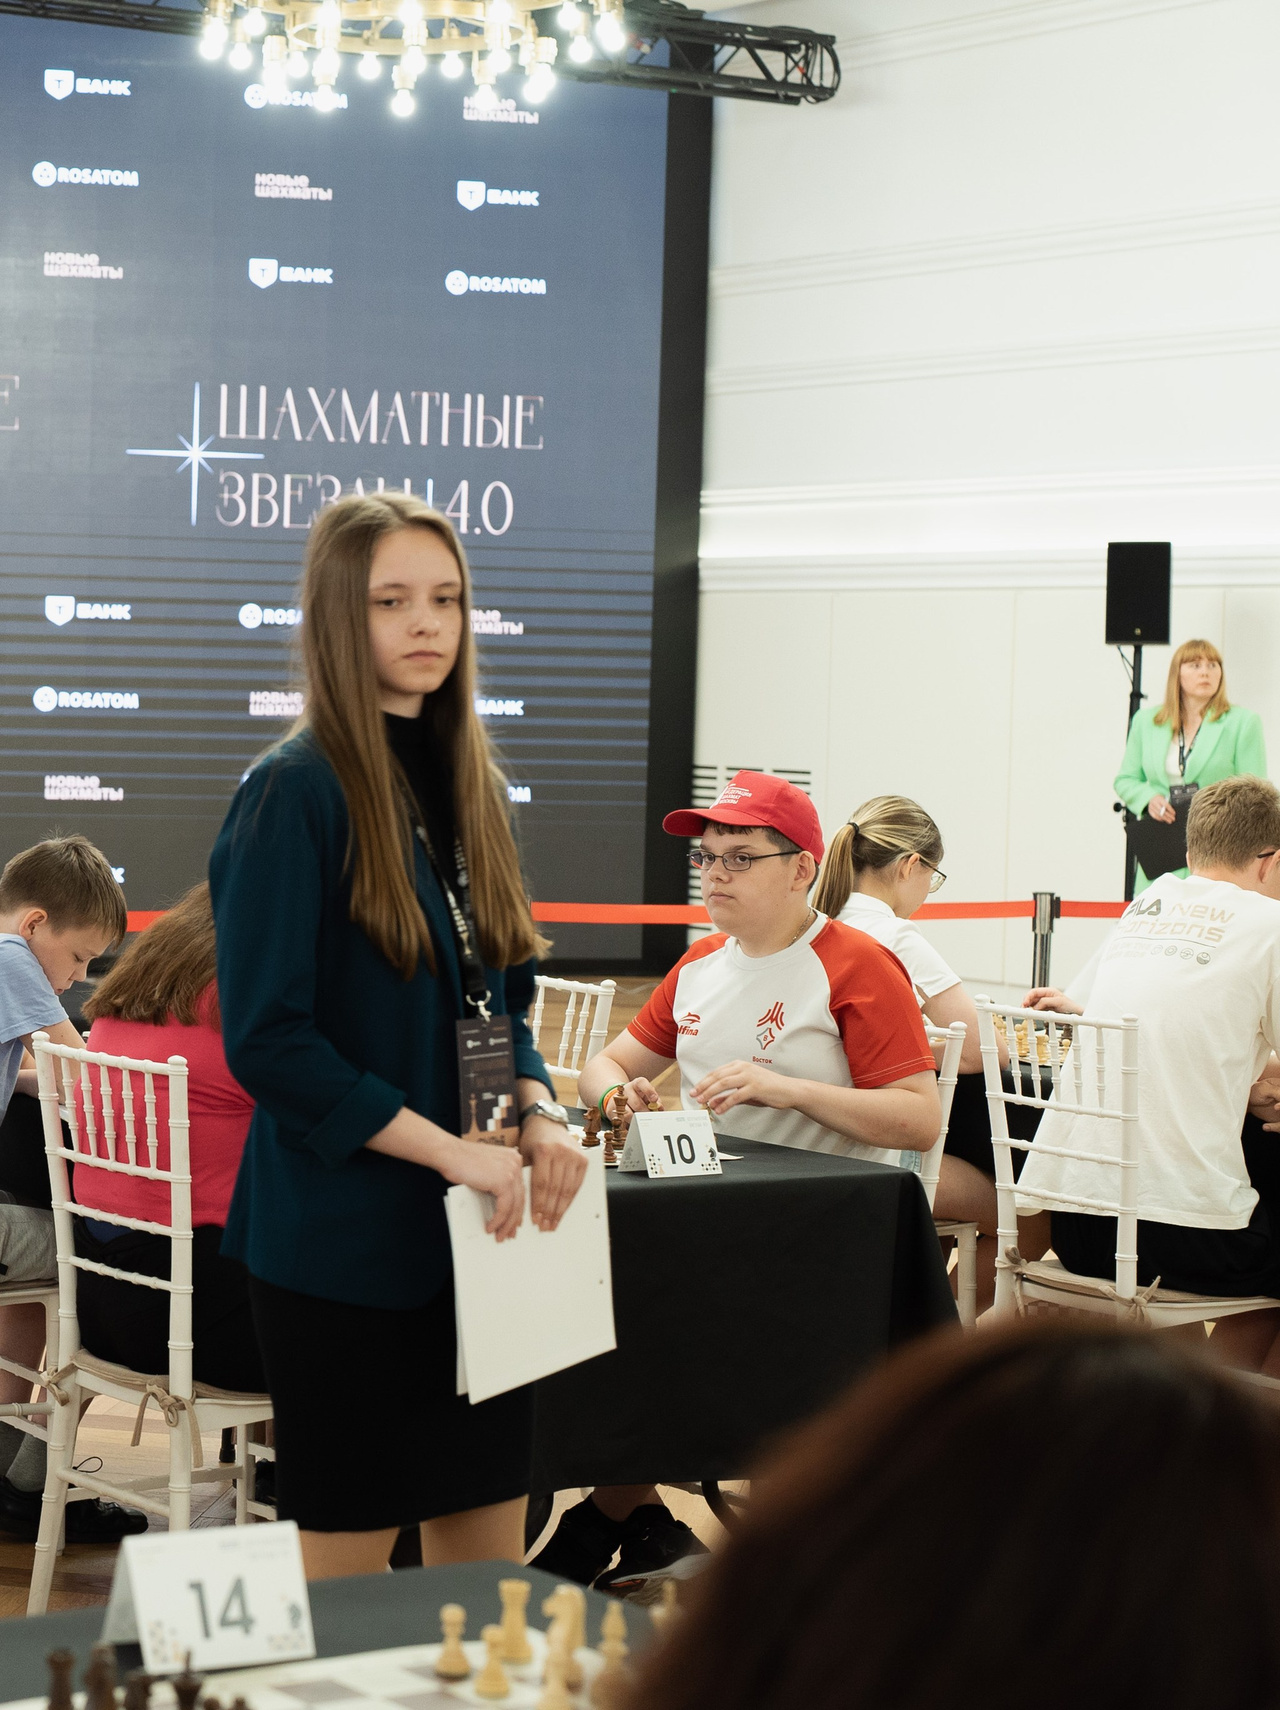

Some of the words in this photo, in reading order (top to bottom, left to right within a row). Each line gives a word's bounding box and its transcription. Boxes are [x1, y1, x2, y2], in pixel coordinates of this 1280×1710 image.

[75, 77, 132, 96] БАНК
[56, 166, 140, 187] ROSATOM
[486, 188, 540, 207] БАНК
[278, 266, 334, 284] БАНК
[468, 275, 547, 295] ROSATOM
[218, 382, 545, 451] ШАХМАТНЫЕ
[445, 479, 515, 536] 4.0
[75, 602, 132, 621] БАНК
[57, 691, 140, 710] ROSATOM
[663, 1133, 696, 1165] 10
[189, 1576, 255, 1640] 14
